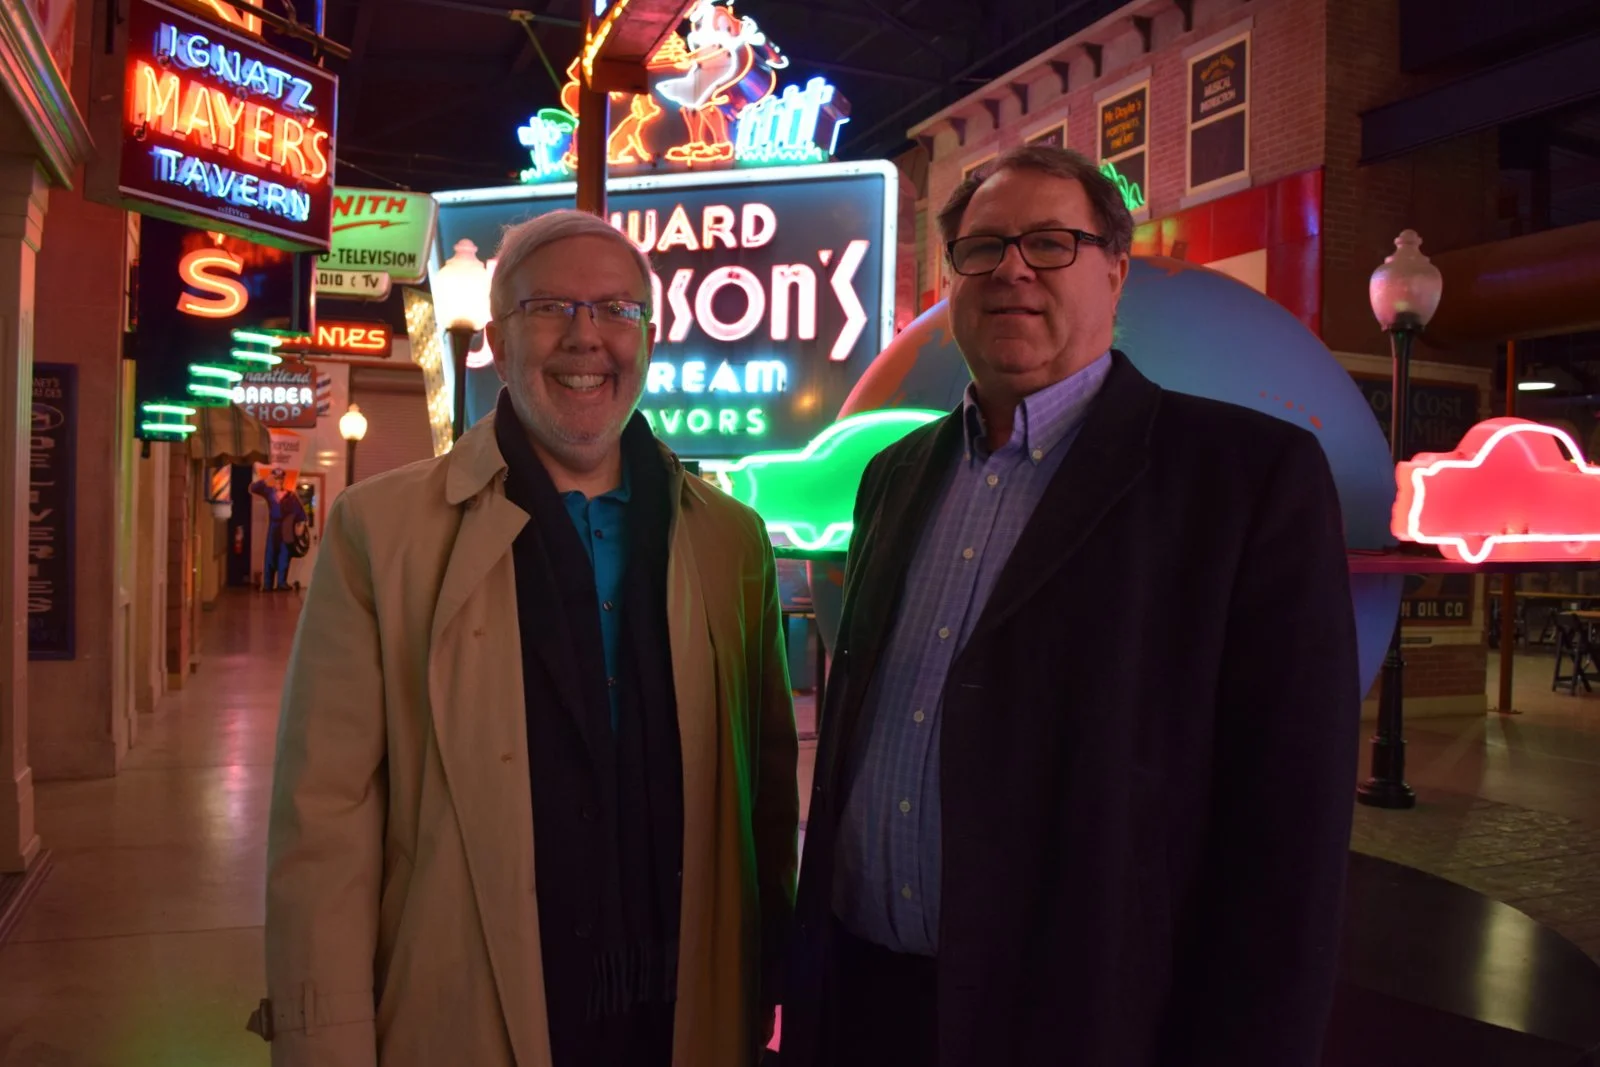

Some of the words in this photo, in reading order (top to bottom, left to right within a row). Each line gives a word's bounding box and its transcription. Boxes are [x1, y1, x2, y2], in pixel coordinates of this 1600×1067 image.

[156, 23, 315, 111] IGNATZ
[131, 60, 329, 183] MAYER'S
[152, 145, 311, 221] TAVERN
[316, 272, 343, 286] DIO
[646, 359, 787, 393] REAM
[232, 386, 313, 405] BARBER
[1413, 390, 1463, 420] Cost
[1418, 601, 1439, 617] OIL
[1444, 601, 1464, 617] CO
